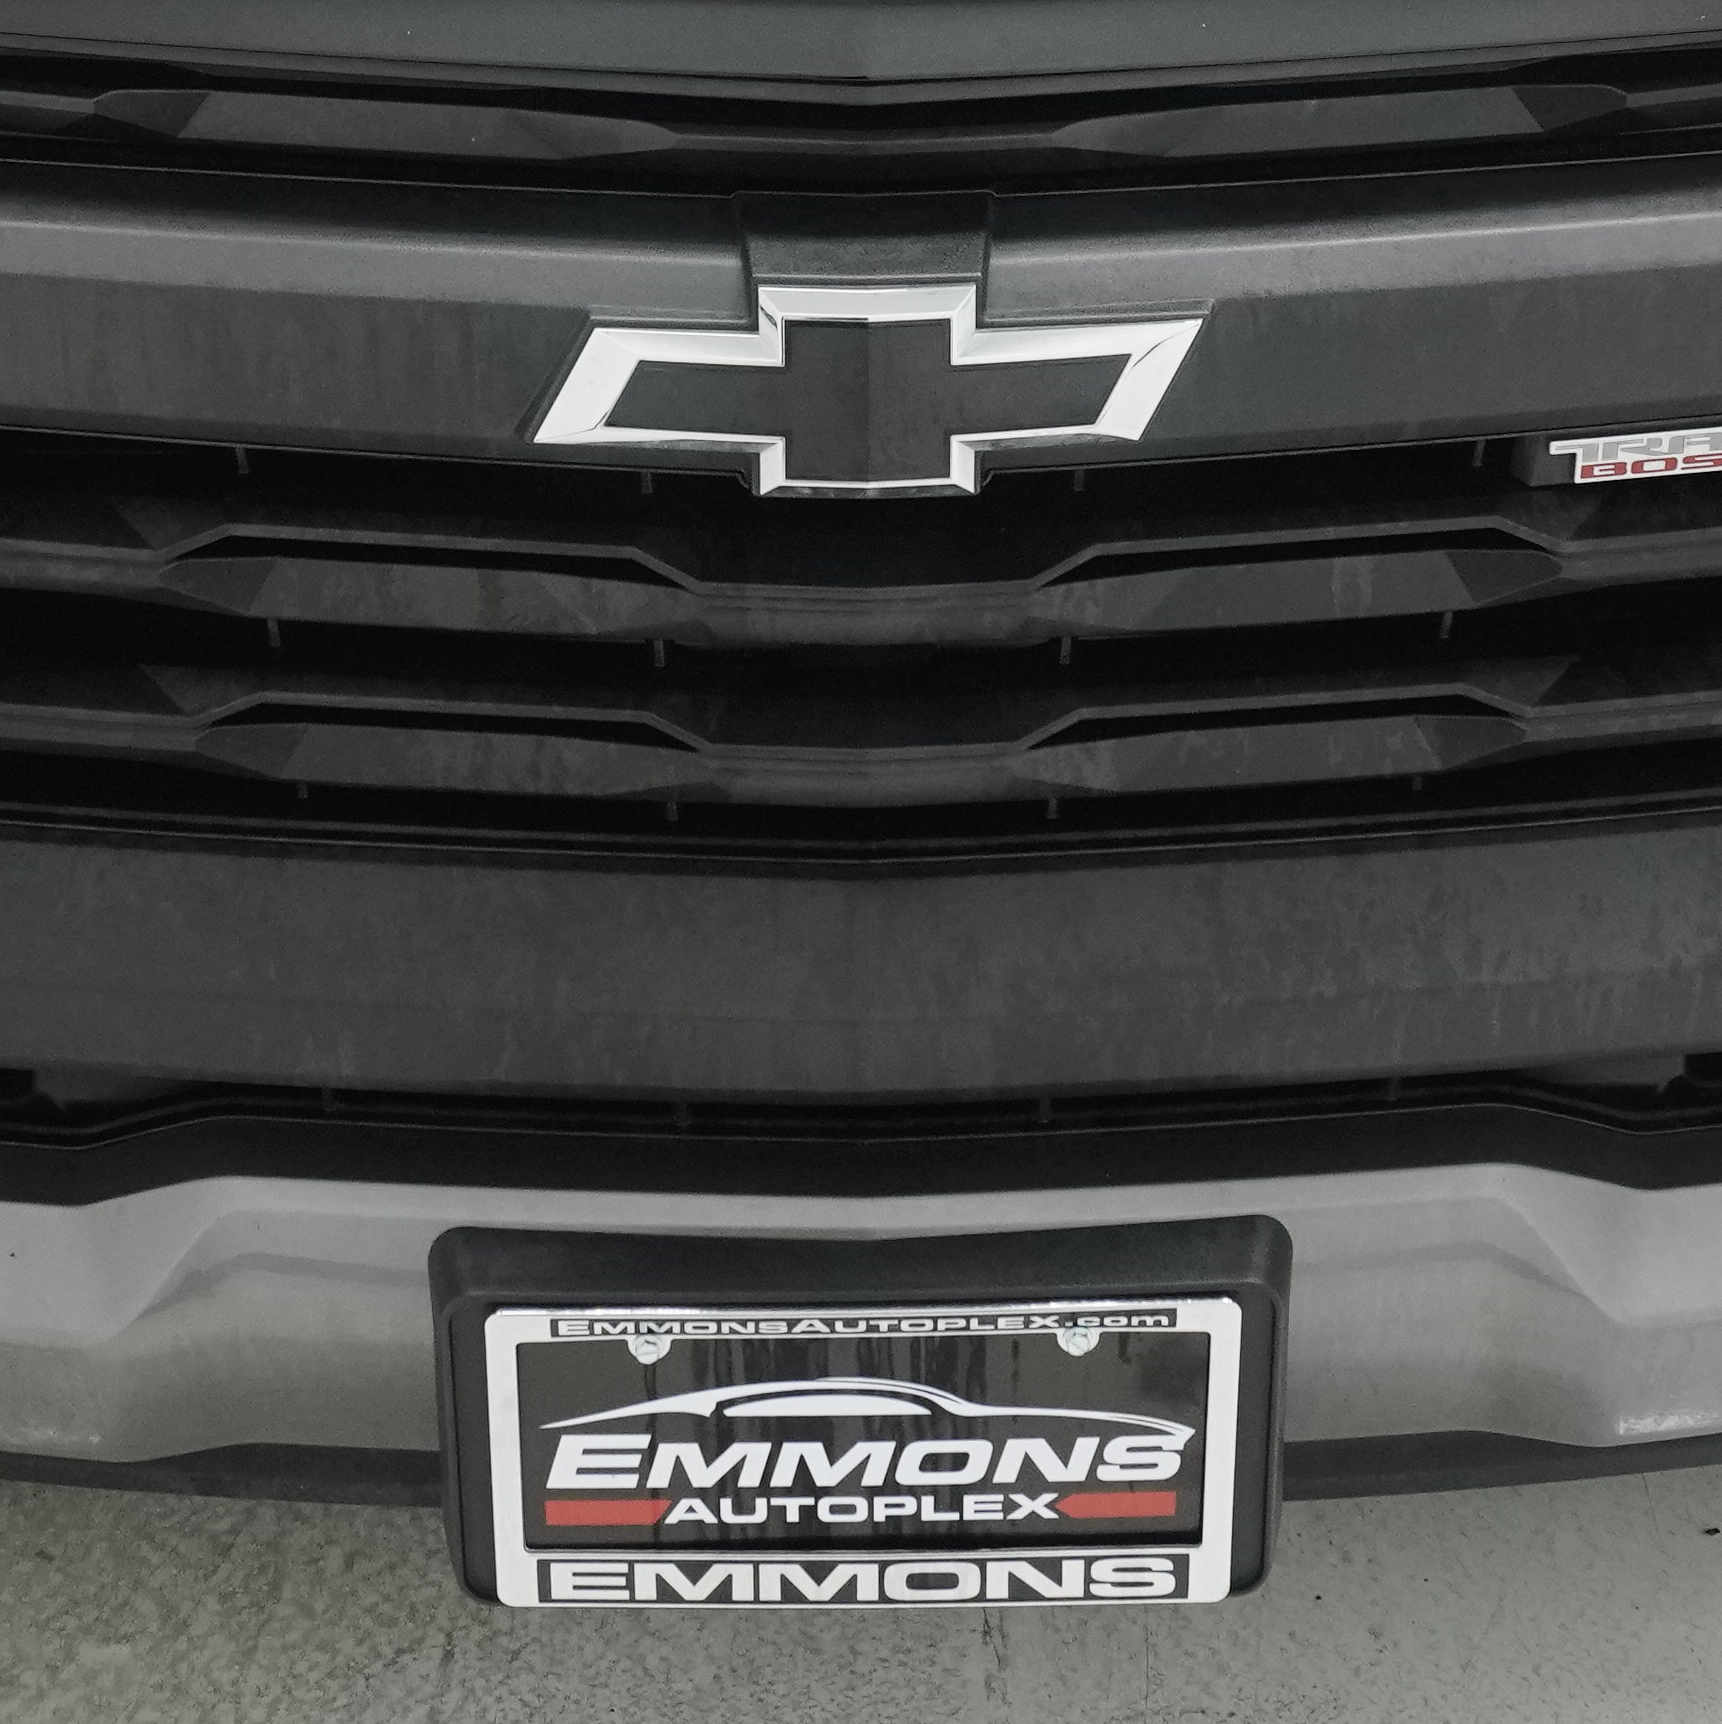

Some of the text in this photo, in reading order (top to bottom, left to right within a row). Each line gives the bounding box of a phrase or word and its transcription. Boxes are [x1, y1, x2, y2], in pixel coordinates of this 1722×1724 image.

[545, 1433, 1184, 1490] EMMONS
[663, 1493, 1061, 1525] AUTOPLEX
[548, 1557, 1178, 1602] EMMONS
